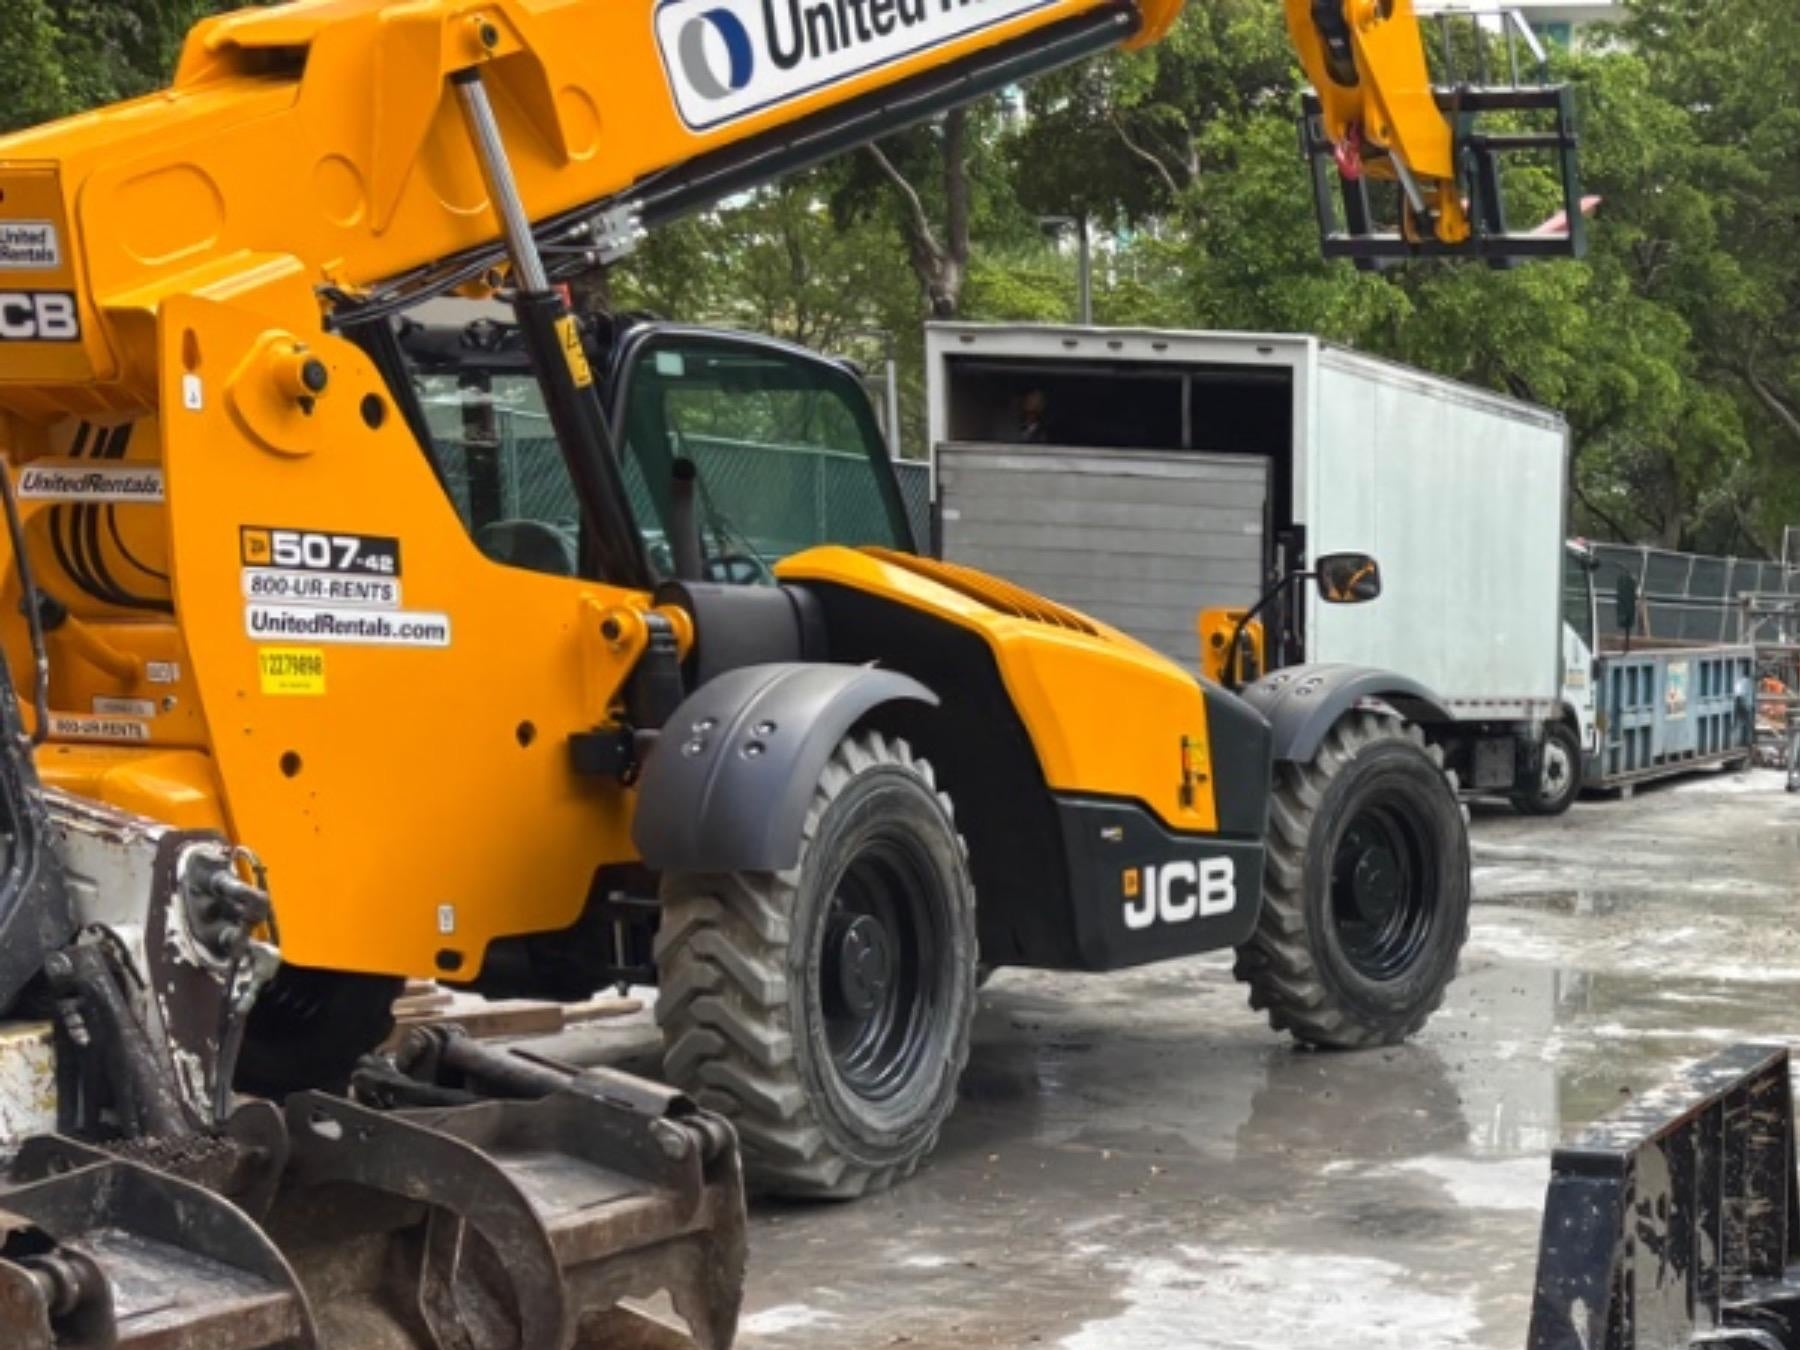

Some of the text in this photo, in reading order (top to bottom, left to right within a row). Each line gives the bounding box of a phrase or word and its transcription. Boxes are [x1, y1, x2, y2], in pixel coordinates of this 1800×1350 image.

[0, 292, 78, 338] CB
[271, 529, 394, 573] 507-42
[251, 576, 393, 601] 800-UR-RENTS
[251, 610, 445, 640] UnitedRentals.com
[1123, 855, 1236, 929] JCB
